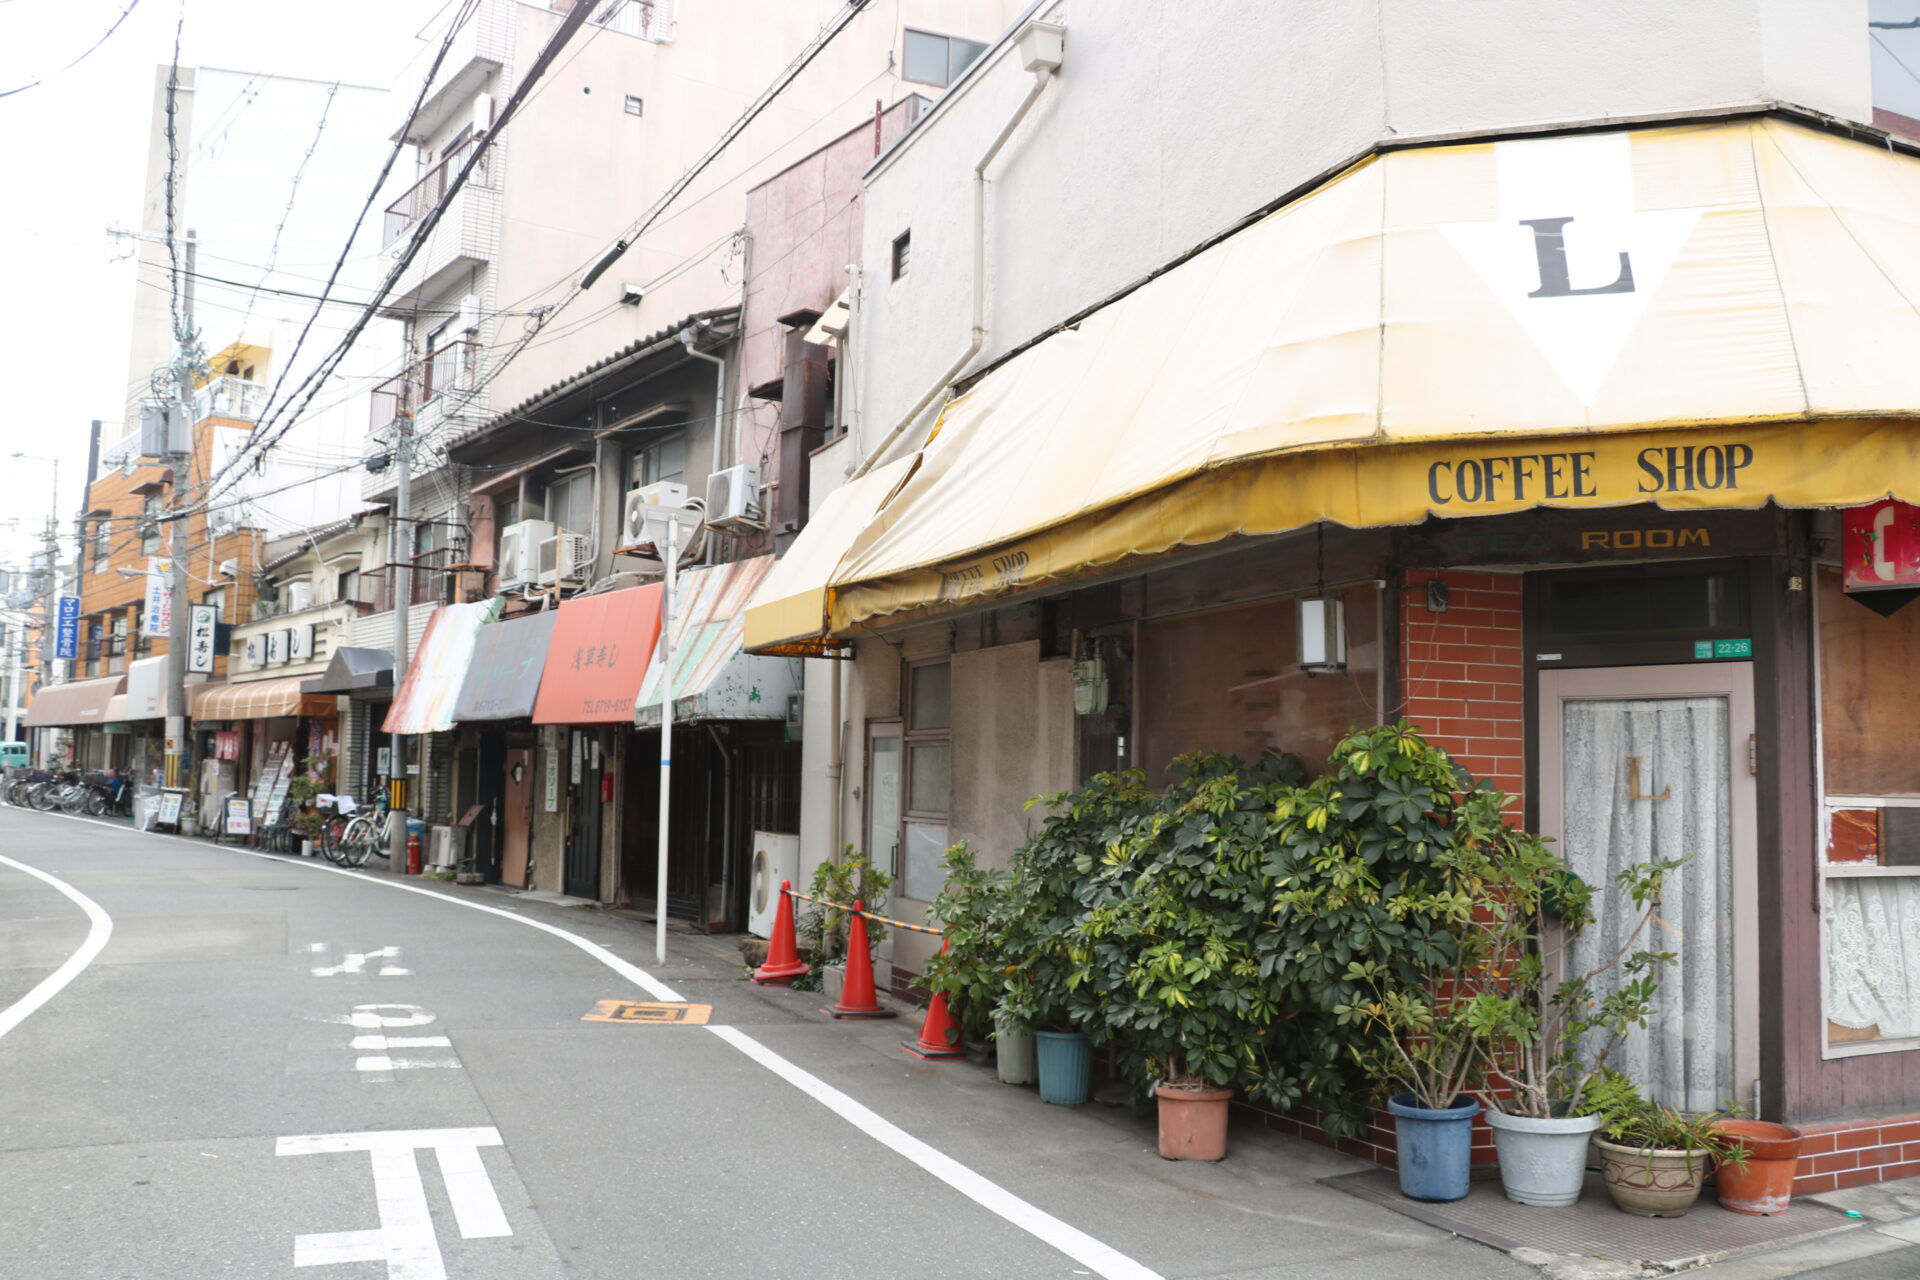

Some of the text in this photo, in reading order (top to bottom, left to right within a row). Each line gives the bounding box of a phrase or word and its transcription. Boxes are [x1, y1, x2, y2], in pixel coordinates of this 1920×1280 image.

[1519, 216, 1637, 299] L
[1427, 443, 1754, 505] COFFEE SHOP
[1457, 527, 1711, 554] TEA ROOM
[1718, 642, 1748, 654] 22-26
[1626, 756, 1671, 802] L
